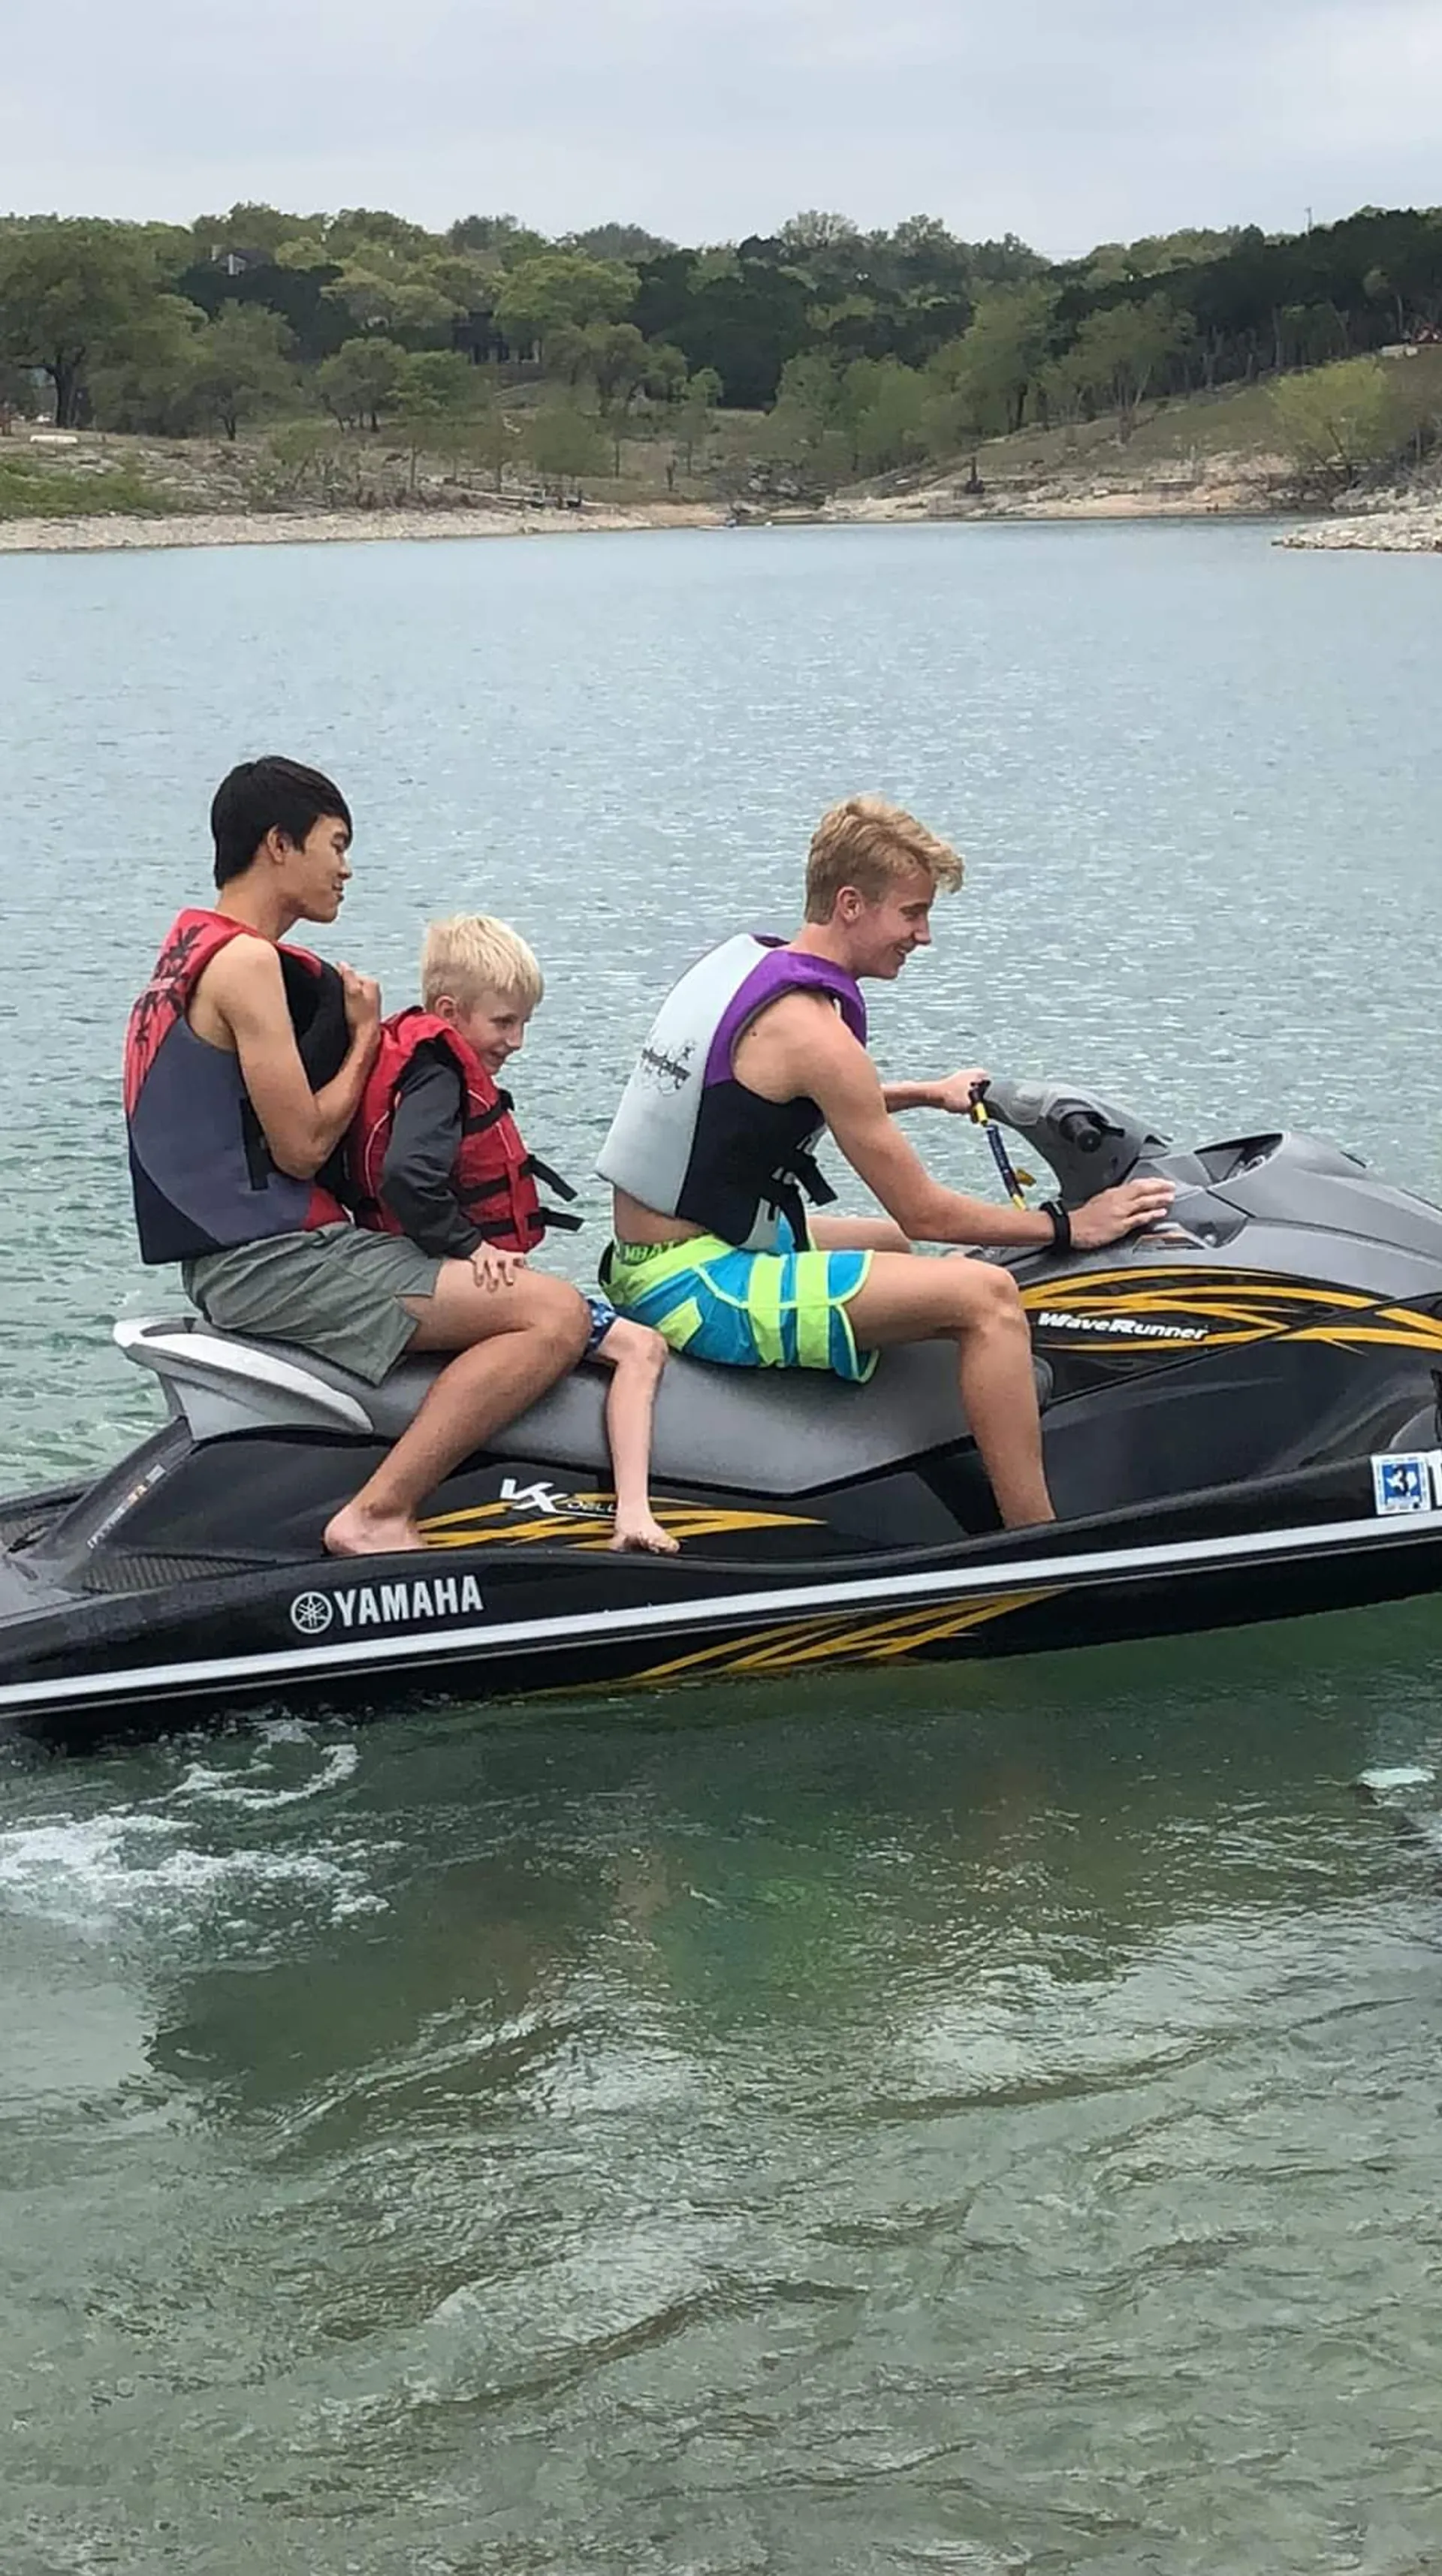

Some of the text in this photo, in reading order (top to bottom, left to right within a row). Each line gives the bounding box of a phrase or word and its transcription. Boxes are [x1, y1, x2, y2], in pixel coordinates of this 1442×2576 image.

[1038, 1312, 1208, 1339] WaveRunner
[500, 1478, 569, 1513] VX
[333, 1575, 483, 1626] YAMAHA
